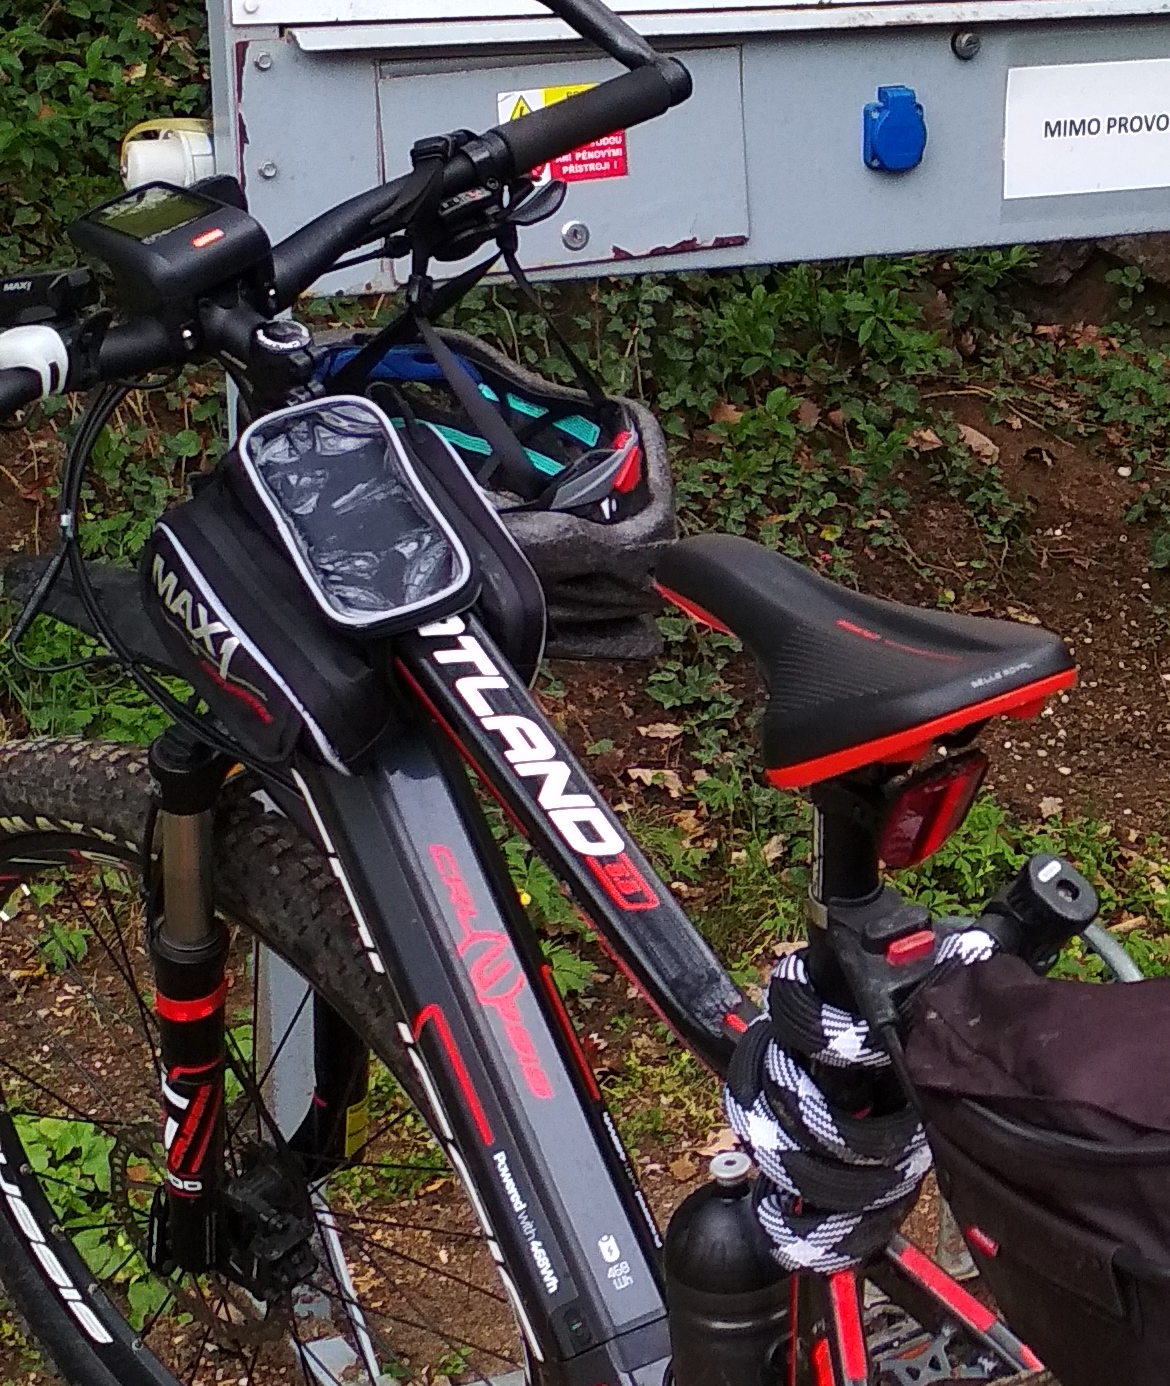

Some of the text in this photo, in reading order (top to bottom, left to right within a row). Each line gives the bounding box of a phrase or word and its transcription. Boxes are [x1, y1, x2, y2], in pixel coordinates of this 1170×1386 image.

[1043, 115, 1102, 139] MIMO
[493, 1151, 527, 1214] Powered
[517, 1207, 538, 1243] with
